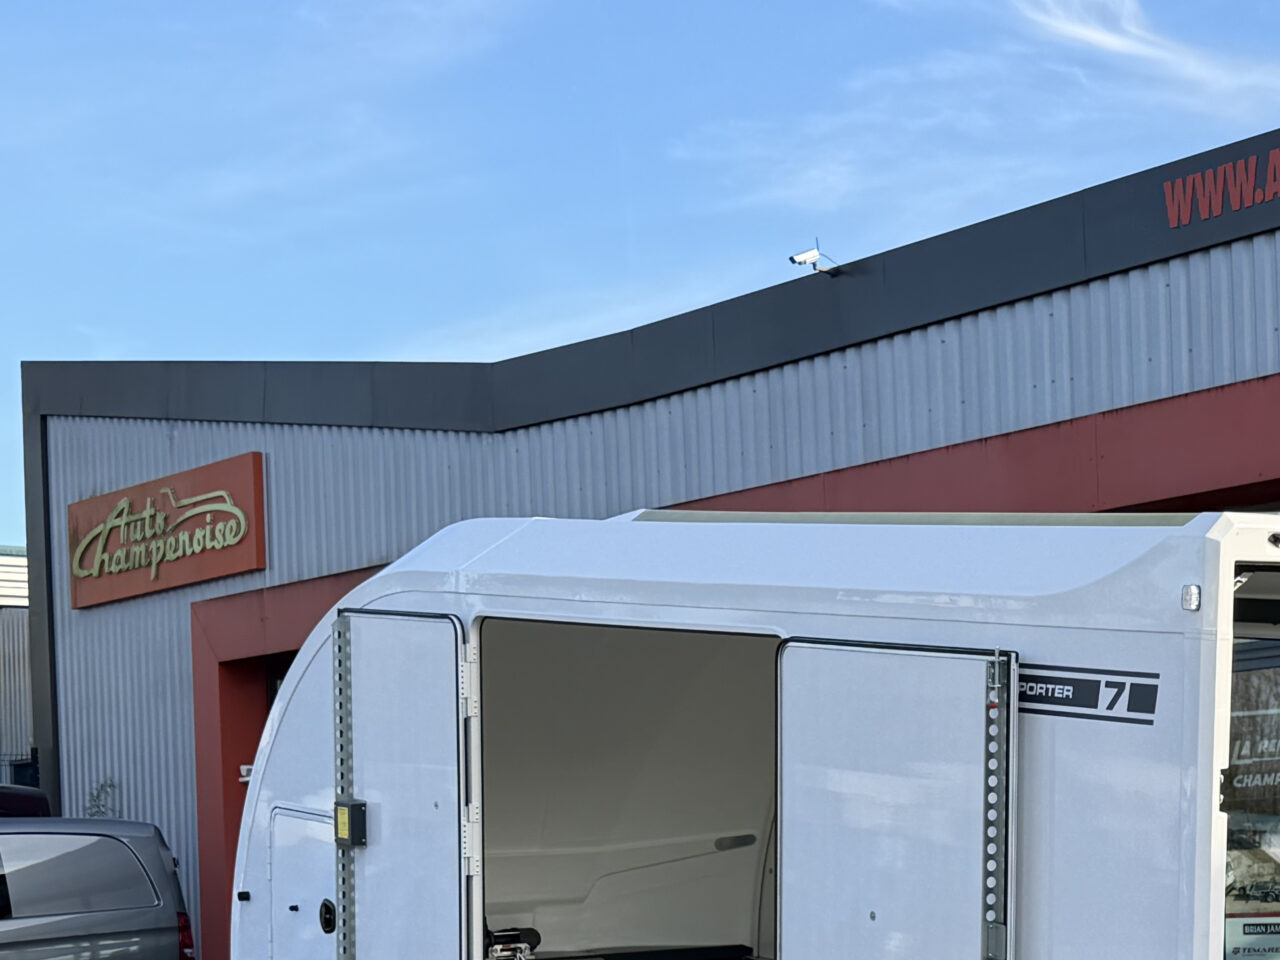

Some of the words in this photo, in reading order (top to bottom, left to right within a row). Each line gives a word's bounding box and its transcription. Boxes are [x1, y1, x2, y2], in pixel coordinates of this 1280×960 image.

[104, 497, 168, 544] Auto
[72, 510, 247, 581] Champenoise
[1018, 682, 1073, 699] PORTER
[1104, 680, 1126, 711] 7
[1244, 925, 1266, 934] BRIAN
